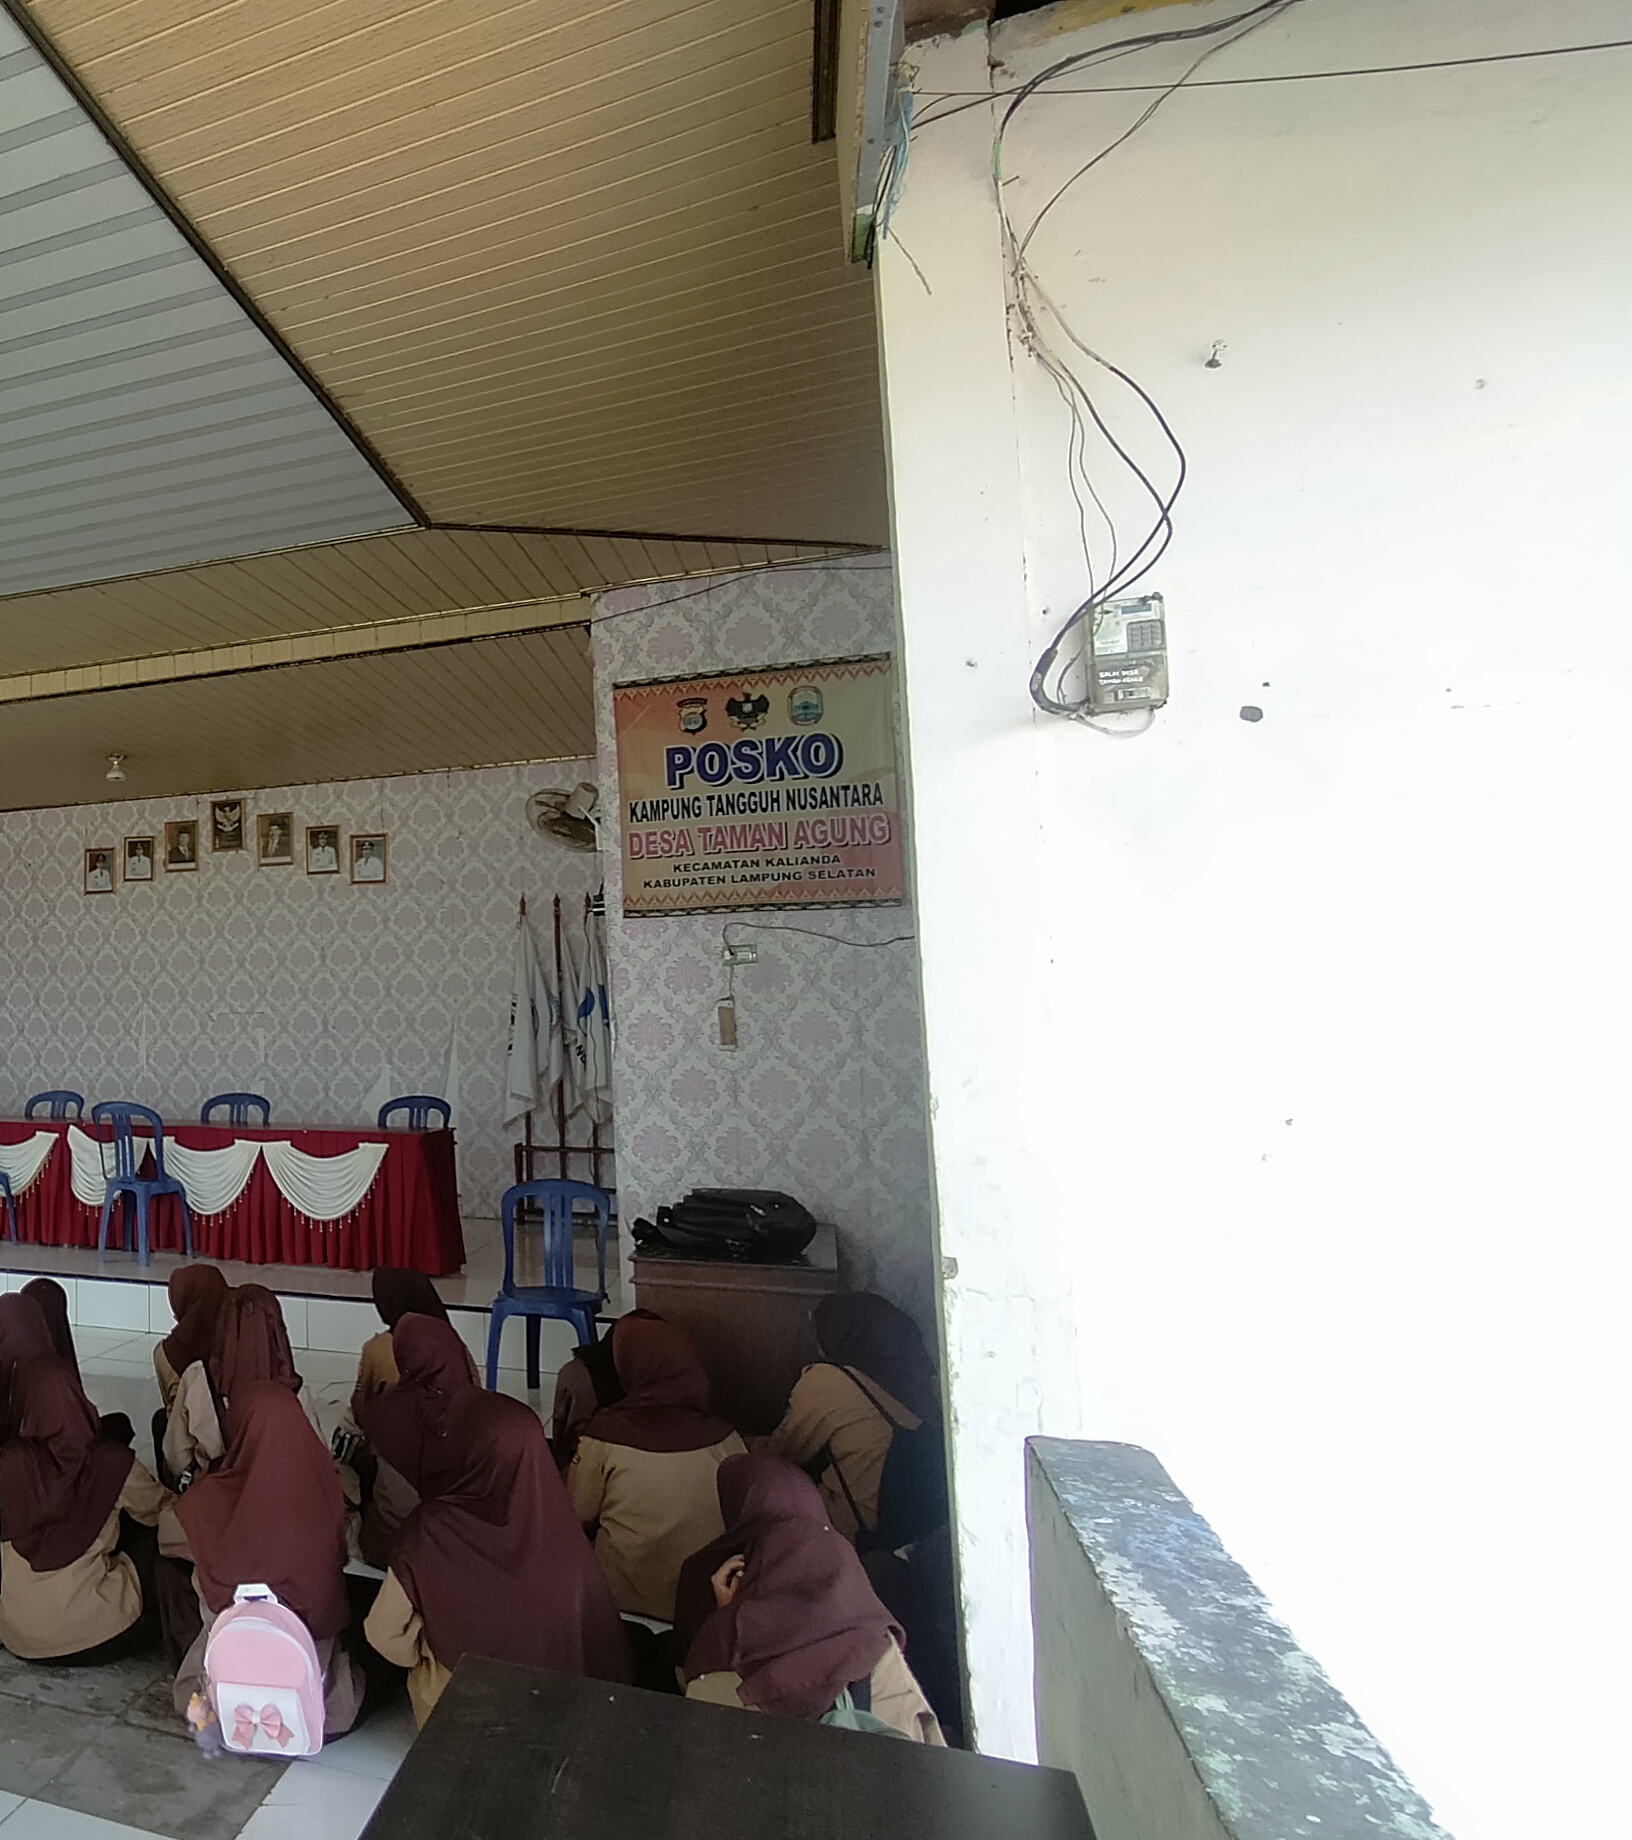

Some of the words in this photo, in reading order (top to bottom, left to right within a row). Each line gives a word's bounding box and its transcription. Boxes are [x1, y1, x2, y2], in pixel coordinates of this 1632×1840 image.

[664, 732, 843, 790] POSKO
[629, 796, 702, 823] KAMPUNG
[706, 789, 781, 817] TANGGUH
[786, 782, 884, 811] NUSANTARA
[628, 828, 695, 859] DESA
[697, 821, 788, 855] TAMAN
[793, 813, 891, 849] AGUNG
[643, 875, 726, 889] KABUPATEN
[731, 871, 803, 884] LAMPUNG
[808, 868, 876, 880] SELATAN
[673, 859, 760, 873] KECAMATAN
[765, 854, 841, 868] KALIANDA
